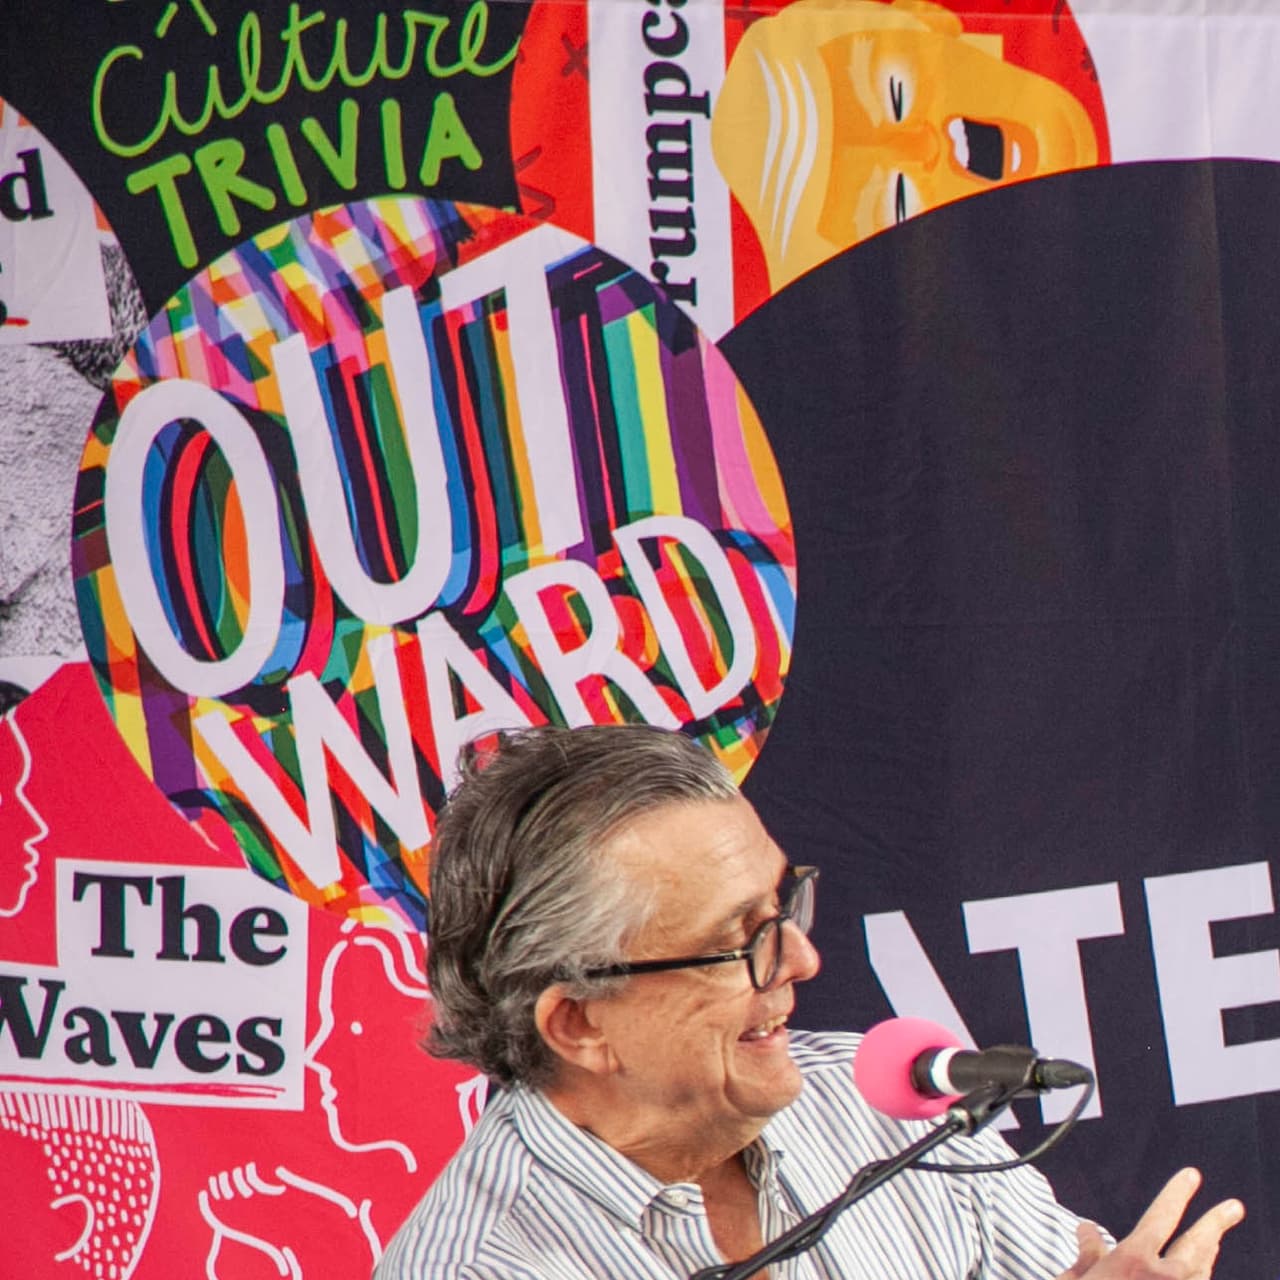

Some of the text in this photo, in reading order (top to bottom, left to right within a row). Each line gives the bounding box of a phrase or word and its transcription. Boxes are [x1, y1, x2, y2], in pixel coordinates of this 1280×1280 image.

[93, 0, 522, 157] Culture
[126, 92, 483, 269] TRIVIA
[641, 0, 711, 306] rumpc
[105, 224, 585, 698] OUT
[194, 515, 758, 889] WARD
[73, 871, 289, 966] The
